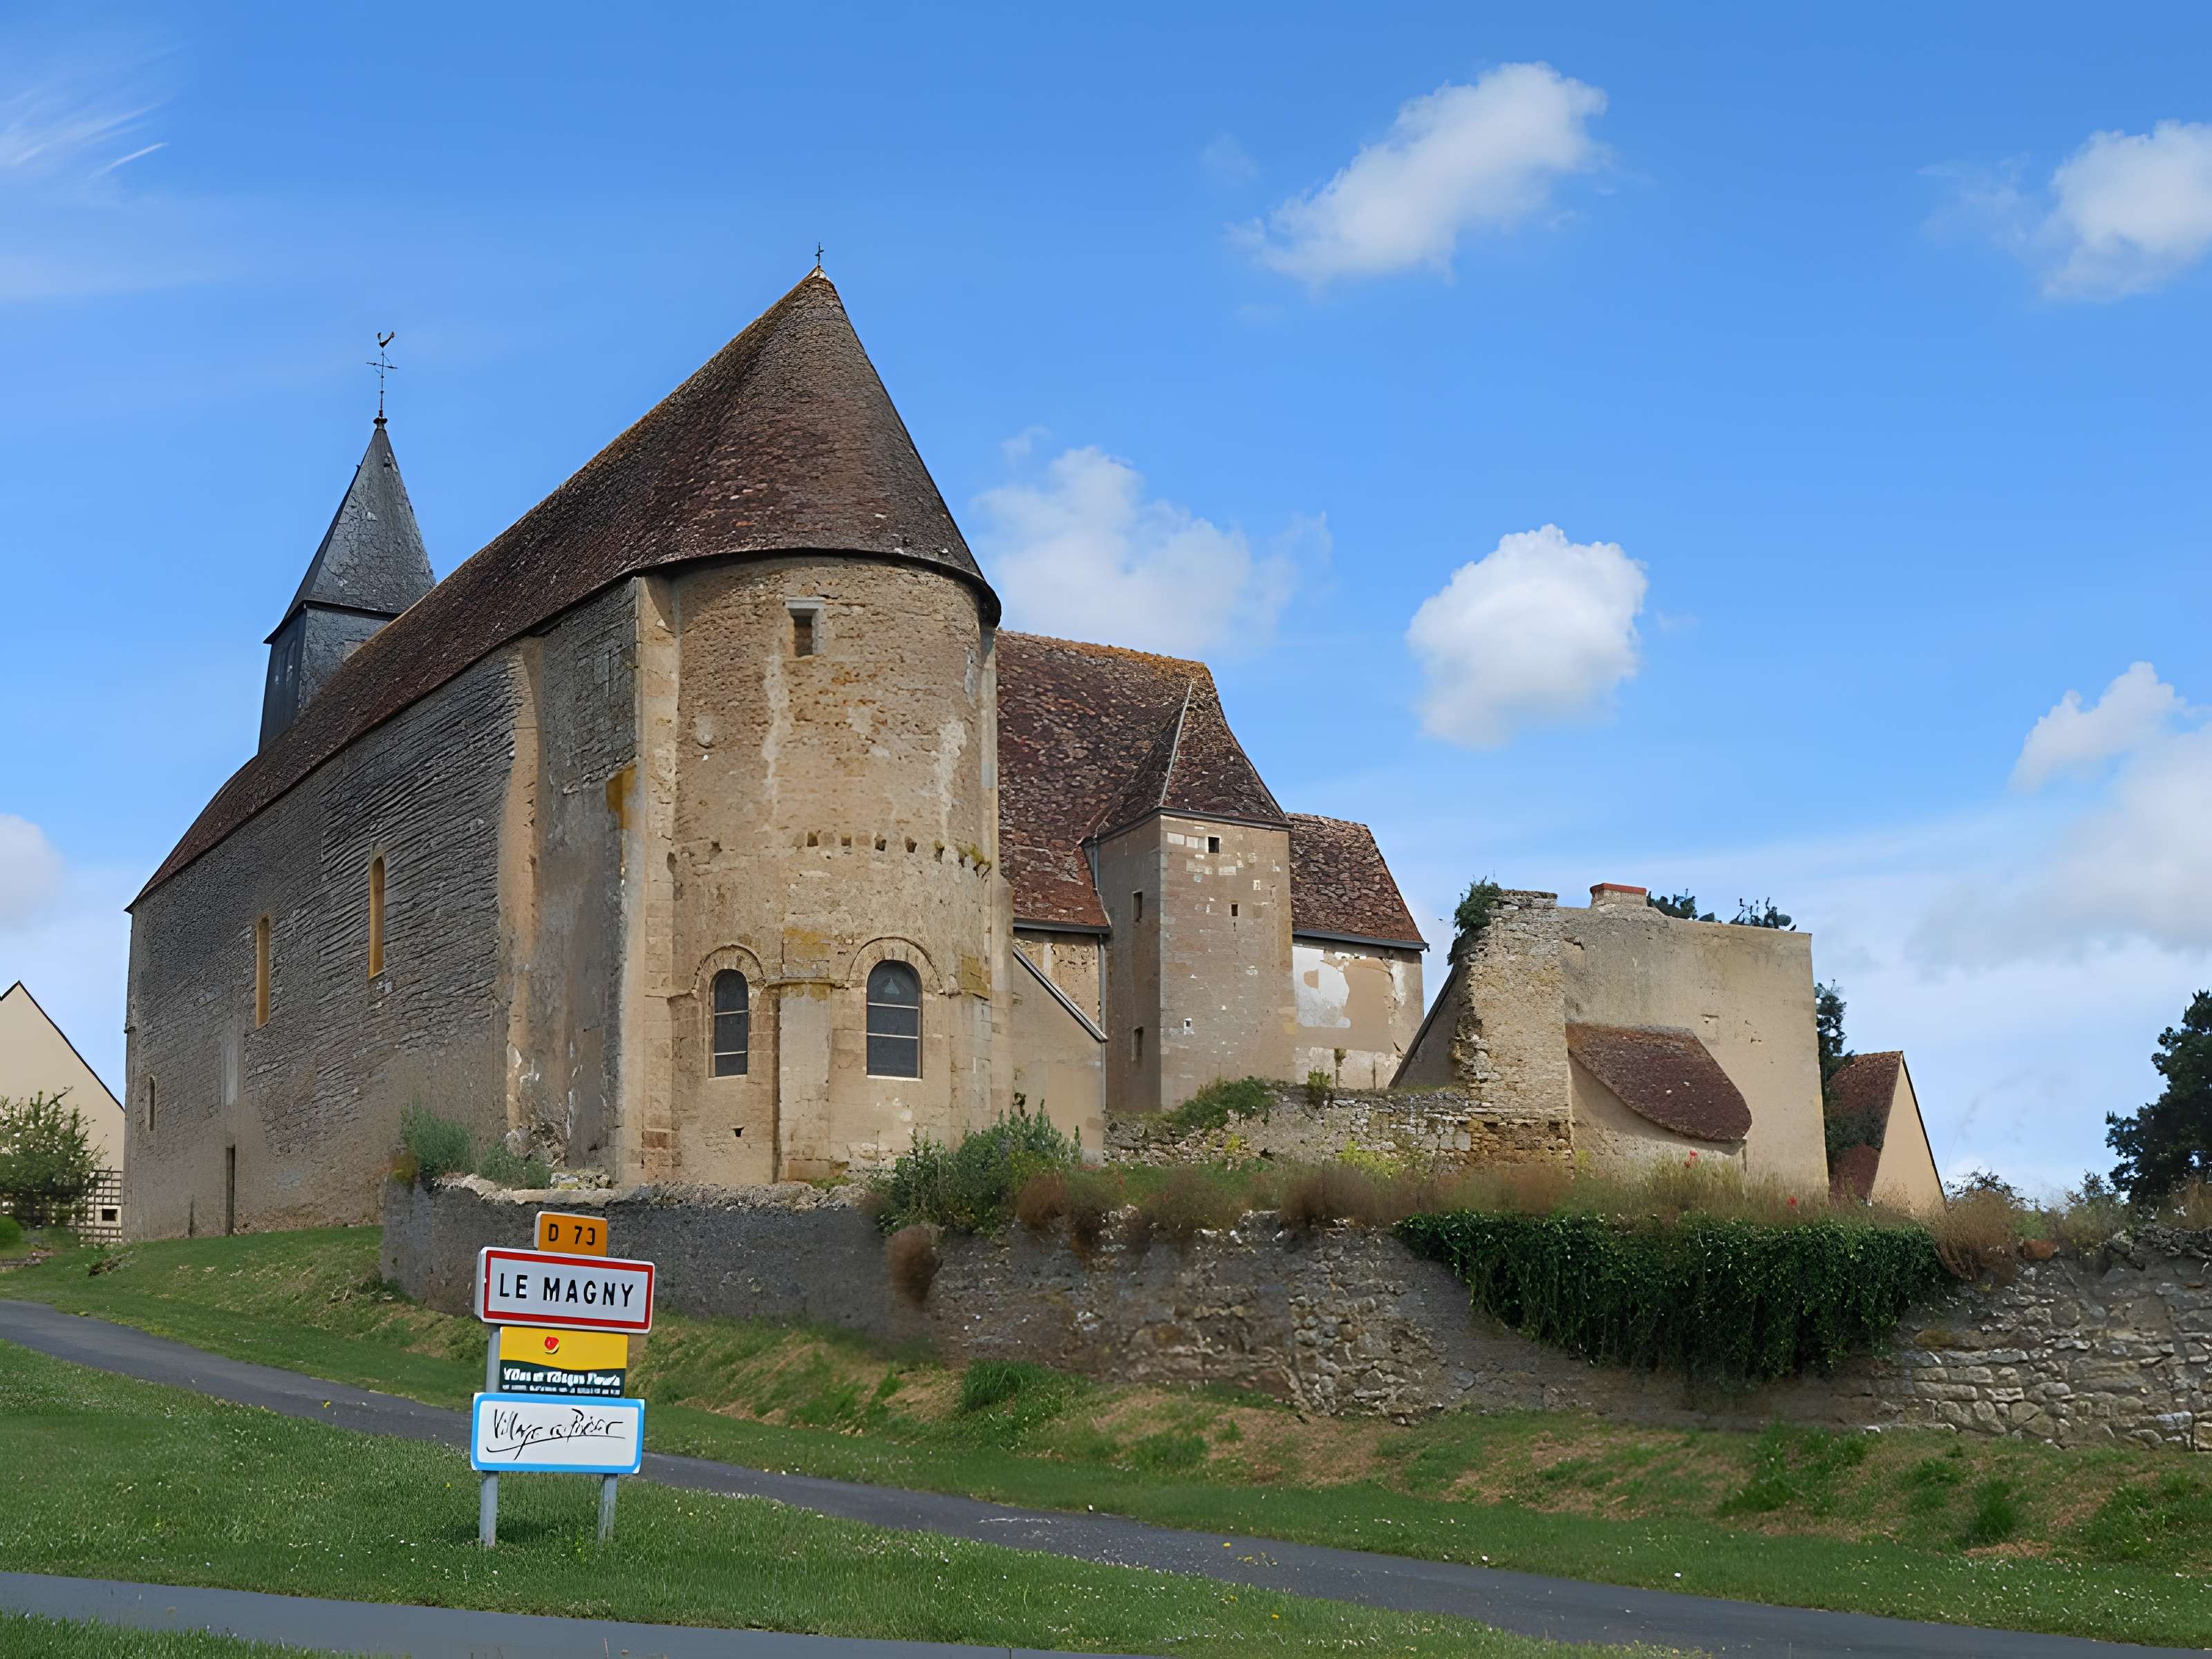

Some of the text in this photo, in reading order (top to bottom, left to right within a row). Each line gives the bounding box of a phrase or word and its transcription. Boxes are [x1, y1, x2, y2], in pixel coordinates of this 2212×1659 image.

[548, 1223, 559, 1242] D
[499, 1273, 634, 1307] LE MAGNY
